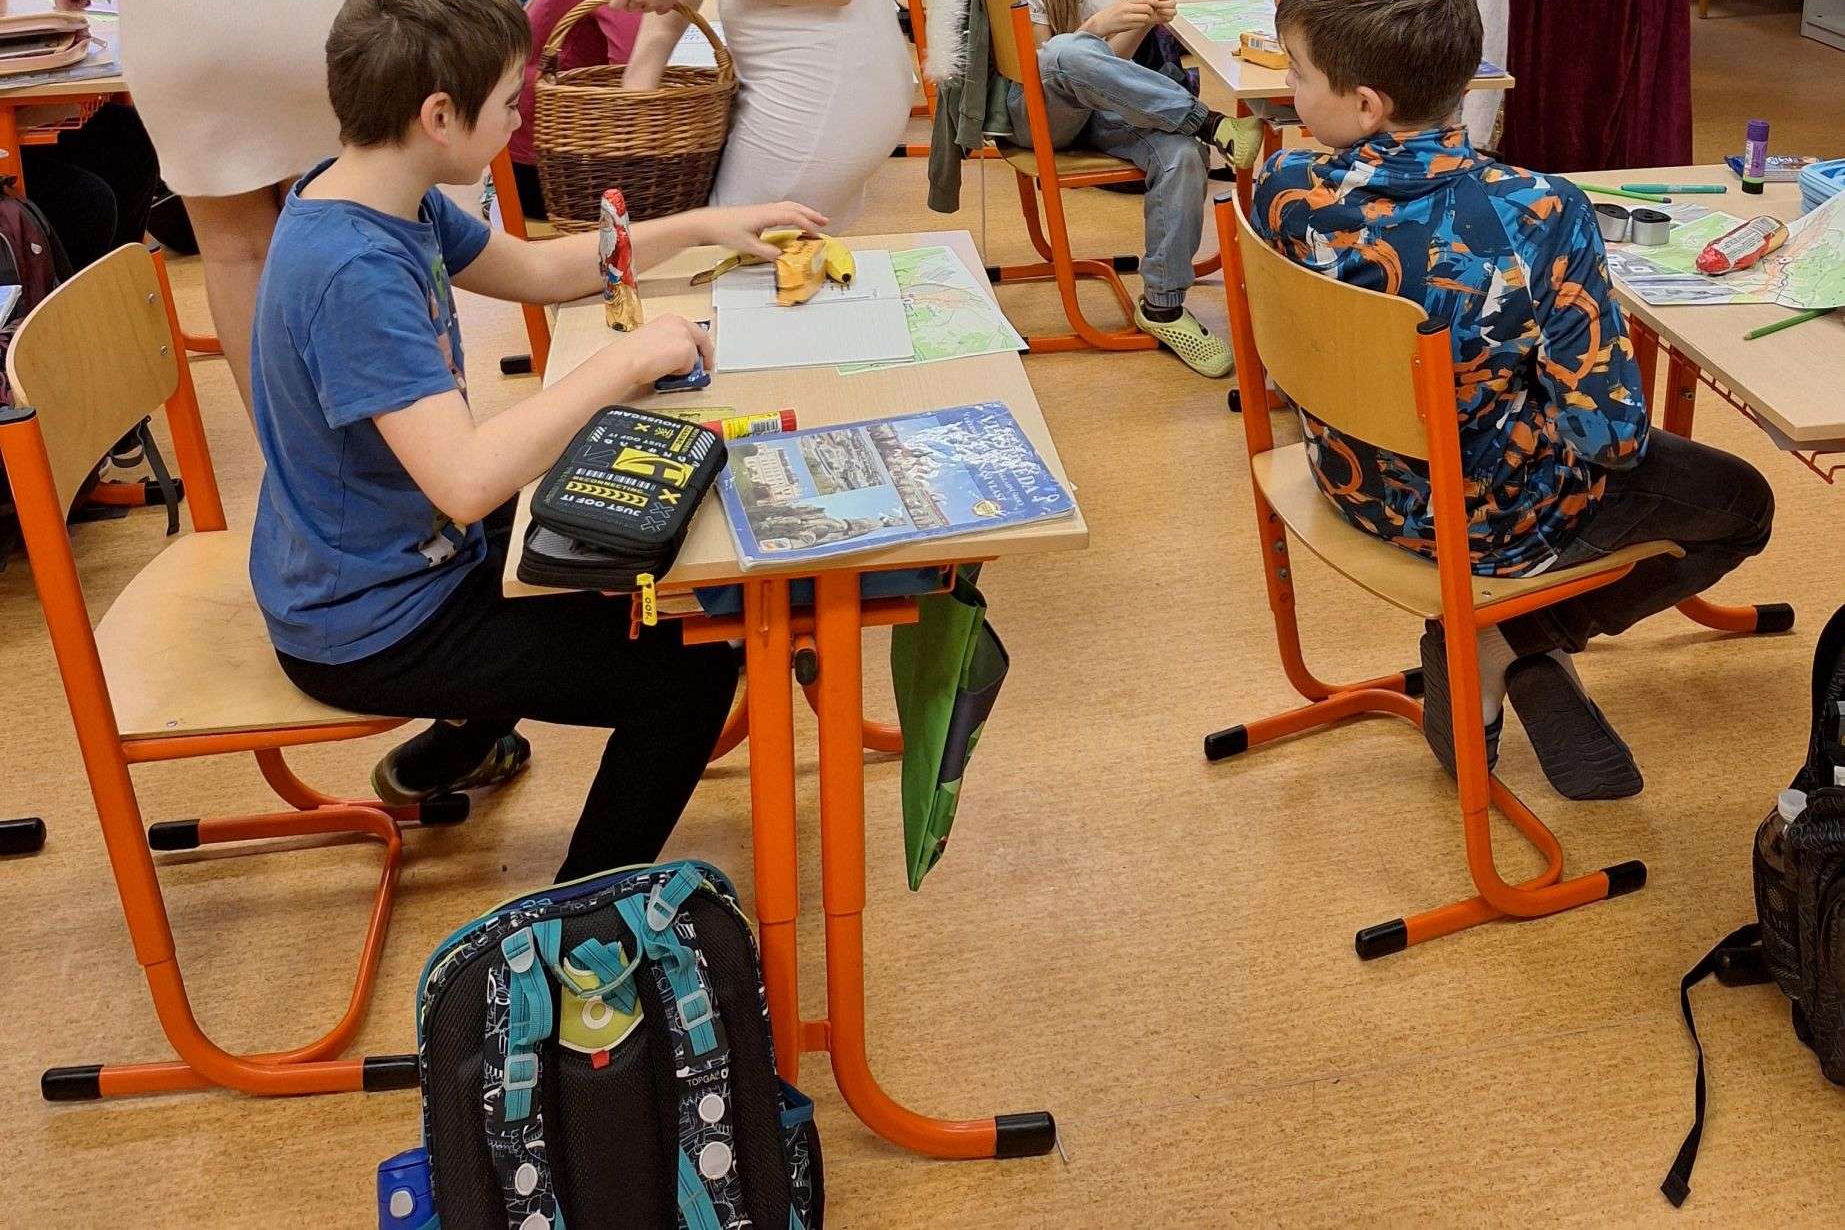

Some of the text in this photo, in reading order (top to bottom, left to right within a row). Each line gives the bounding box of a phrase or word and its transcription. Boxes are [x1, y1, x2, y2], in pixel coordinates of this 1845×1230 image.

[560, 494, 642, 517] JUST OOF IT
[686, 1073, 721, 1088] TOPGAL
